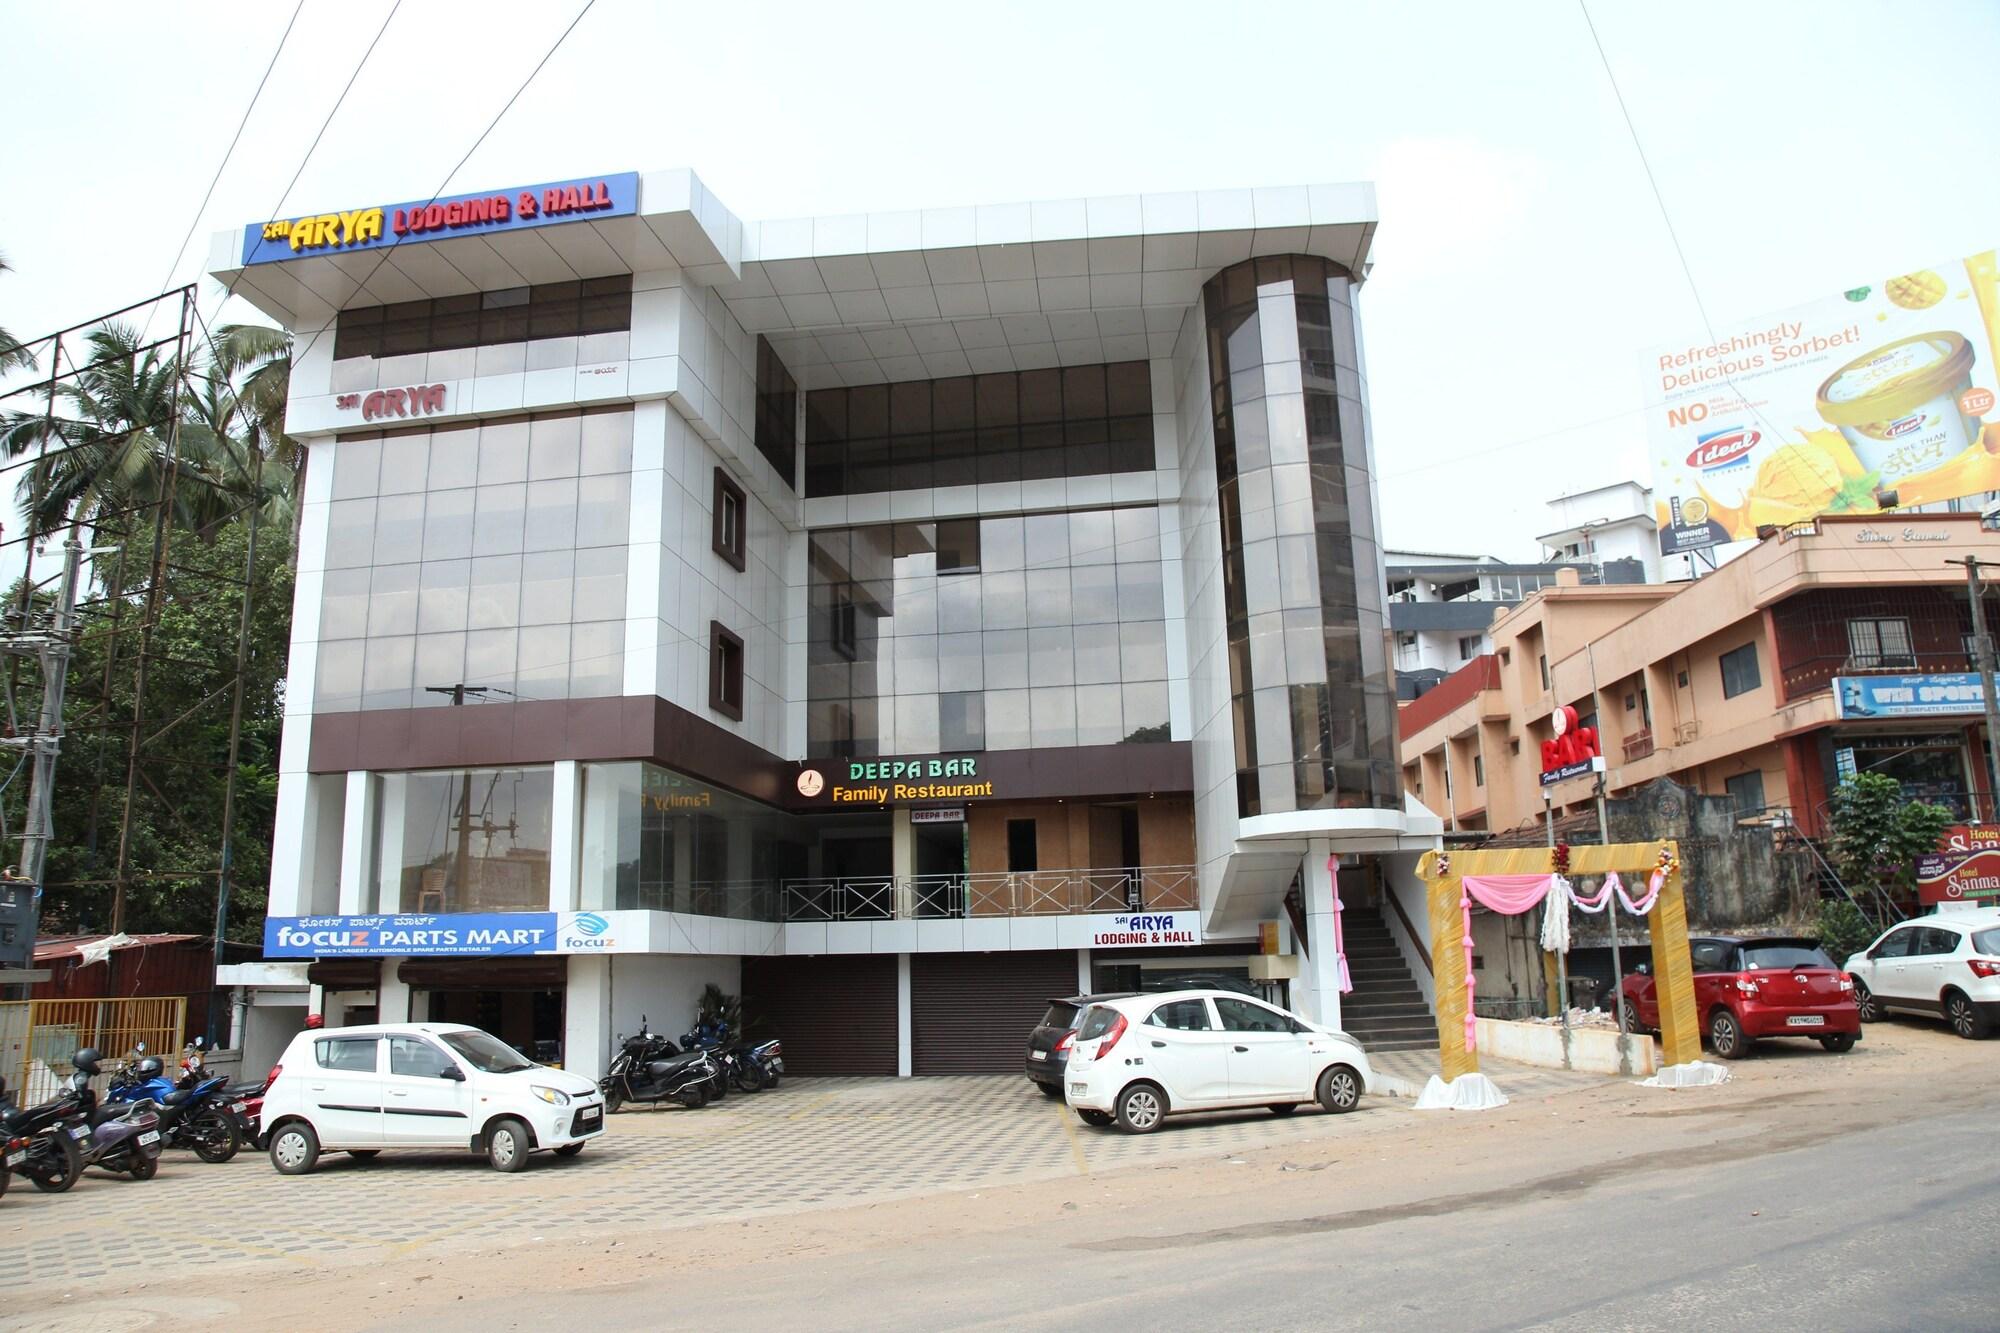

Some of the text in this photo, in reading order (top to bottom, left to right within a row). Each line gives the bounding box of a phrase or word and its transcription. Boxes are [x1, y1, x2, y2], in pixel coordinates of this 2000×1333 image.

[263, 182, 614, 252] SAI ARYA LODGING & HALL
[1659, 321, 1803, 372] Refreshingly
[1662, 324, 1861, 392] Delicious Sorbet!
[336, 383, 447, 422] SAI ARYA
[1667, 402, 1709, 428] NO
[1696, 432, 1754, 465] Ideal
[1920, 431, 1947, 447] THAN
[1675, 527, 1710, 540] WINNER
[850, 758, 977, 781] DEEPA BAR
[833, 781, 993, 803] Family Restaurant
[914, 811, 961, 820] DEEPA BAR
[1959, 867, 1978, 878] Hotel
[1115, 915, 1174, 931] SAI ARYA
[277, 926, 545, 947] focuz PARTS MART
[566, 936, 616, 948] focuz
[1095, 931, 1195, 945] LODGING & HALL
